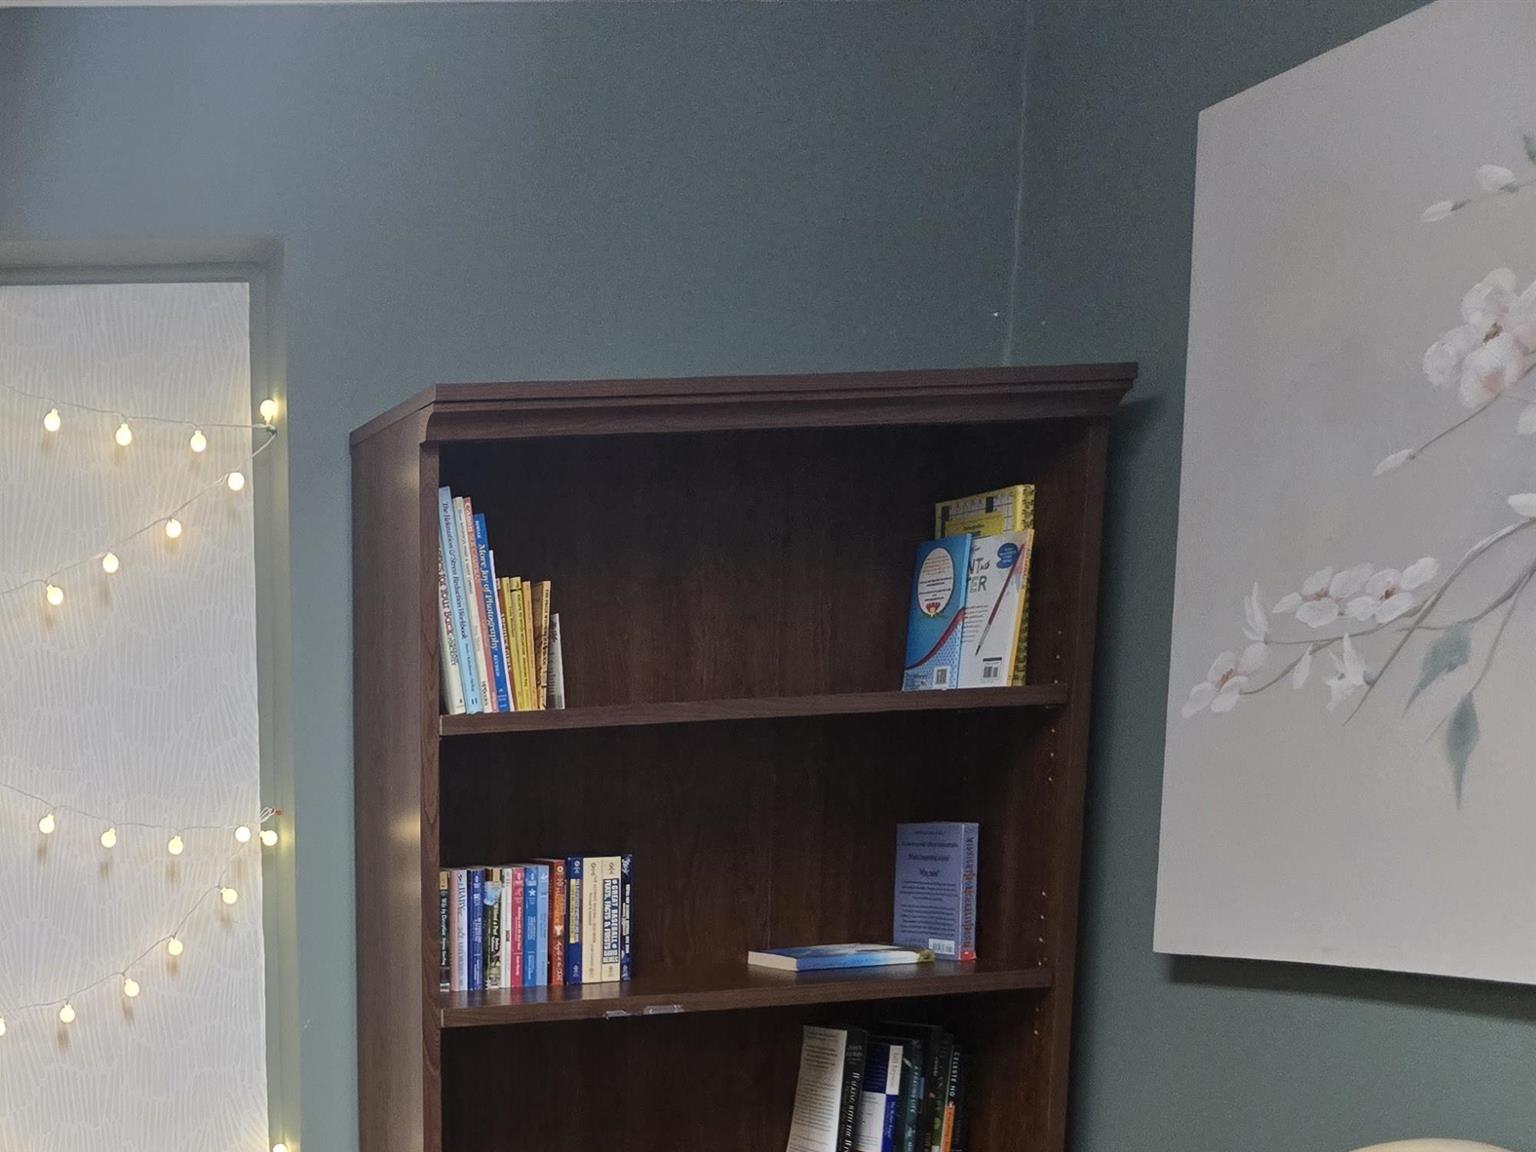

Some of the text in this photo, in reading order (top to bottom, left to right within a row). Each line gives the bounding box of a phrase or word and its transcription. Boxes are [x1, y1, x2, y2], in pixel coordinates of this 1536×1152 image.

[444, 514, 454, 548] Relaxation
[464, 502, 474, 532] Canon
[450, 556, 458, 575] Stress
[439, 585, 450, 610] Your
[452, 575, 463, 607] Reduction
[477, 543, 499, 649] More Joy of Photography
[443, 610, 454, 636] Back
[457, 607, 468, 639] Workbook
[603, 900, 611, 919] FACTS
[949, 1051, 959, 1097] CELESTE NG
